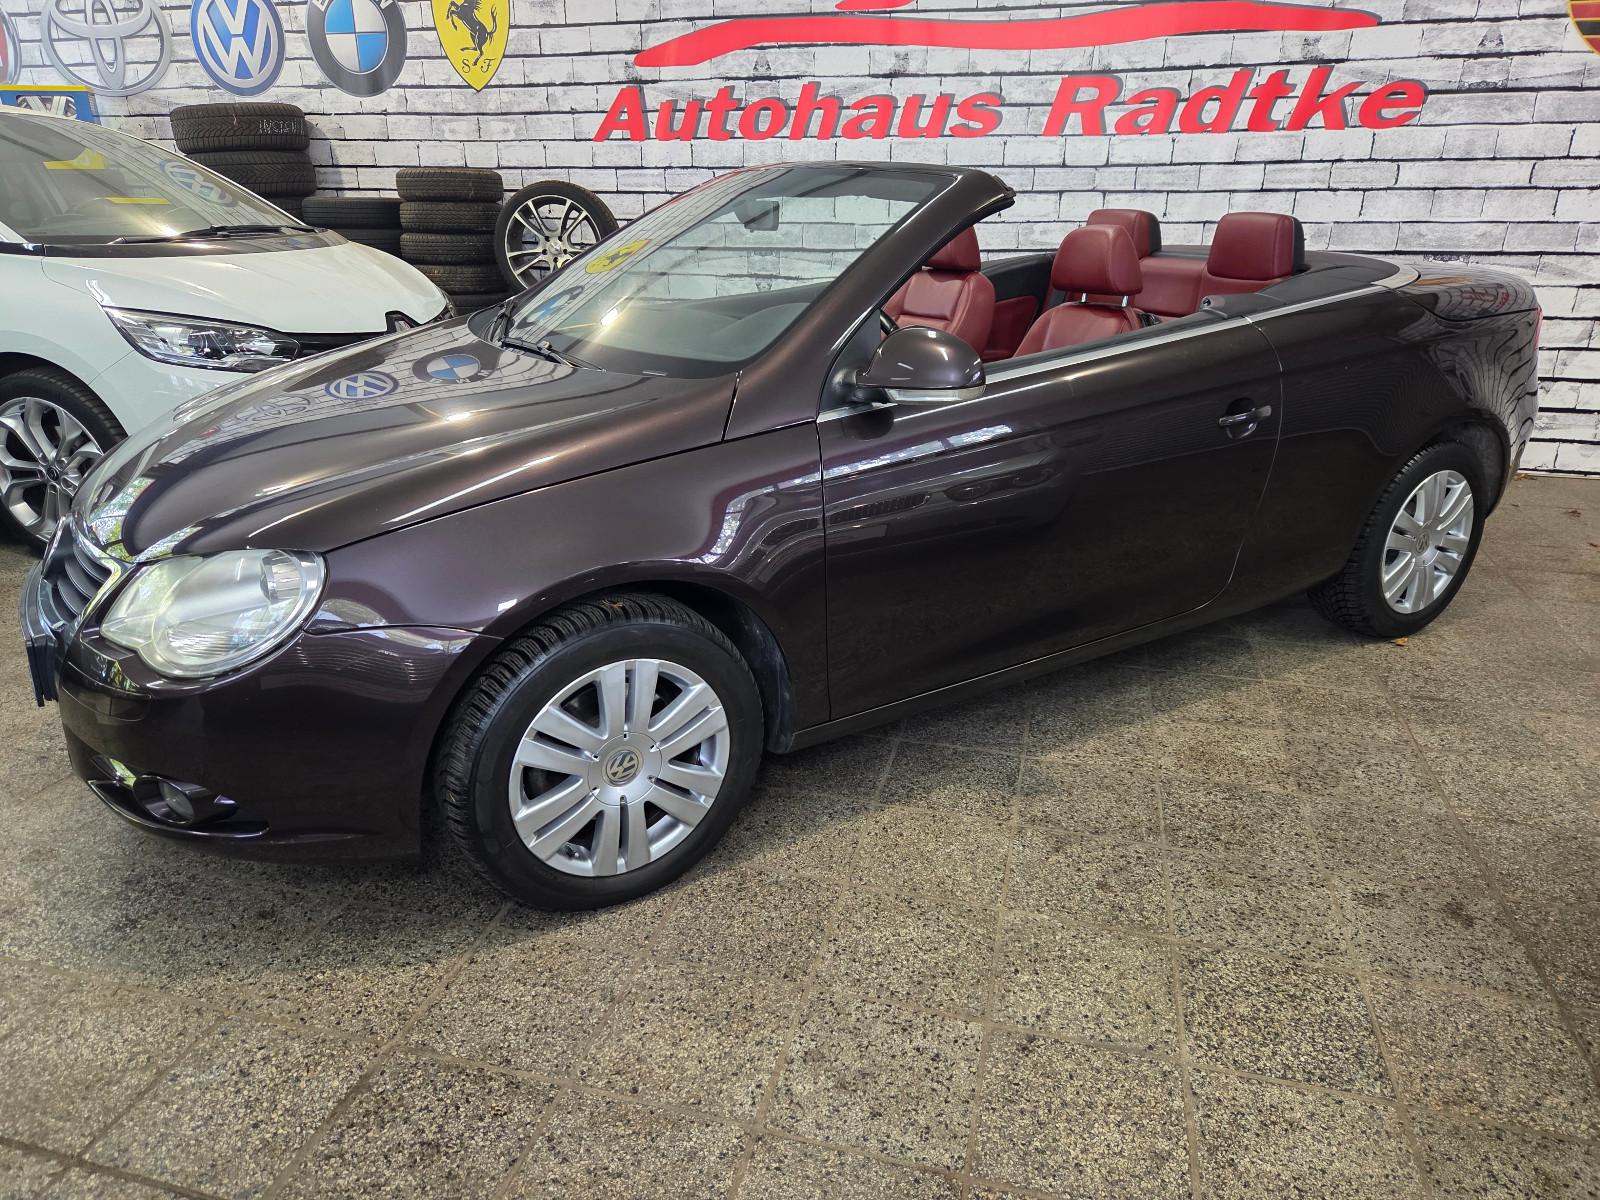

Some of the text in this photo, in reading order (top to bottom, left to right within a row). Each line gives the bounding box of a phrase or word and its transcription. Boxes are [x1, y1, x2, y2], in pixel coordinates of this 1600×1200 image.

[462, 57, 497, 73] S F
[592, 65, 1428, 142] Autohaus Radtke
[607, 751, 639, 781] VW
